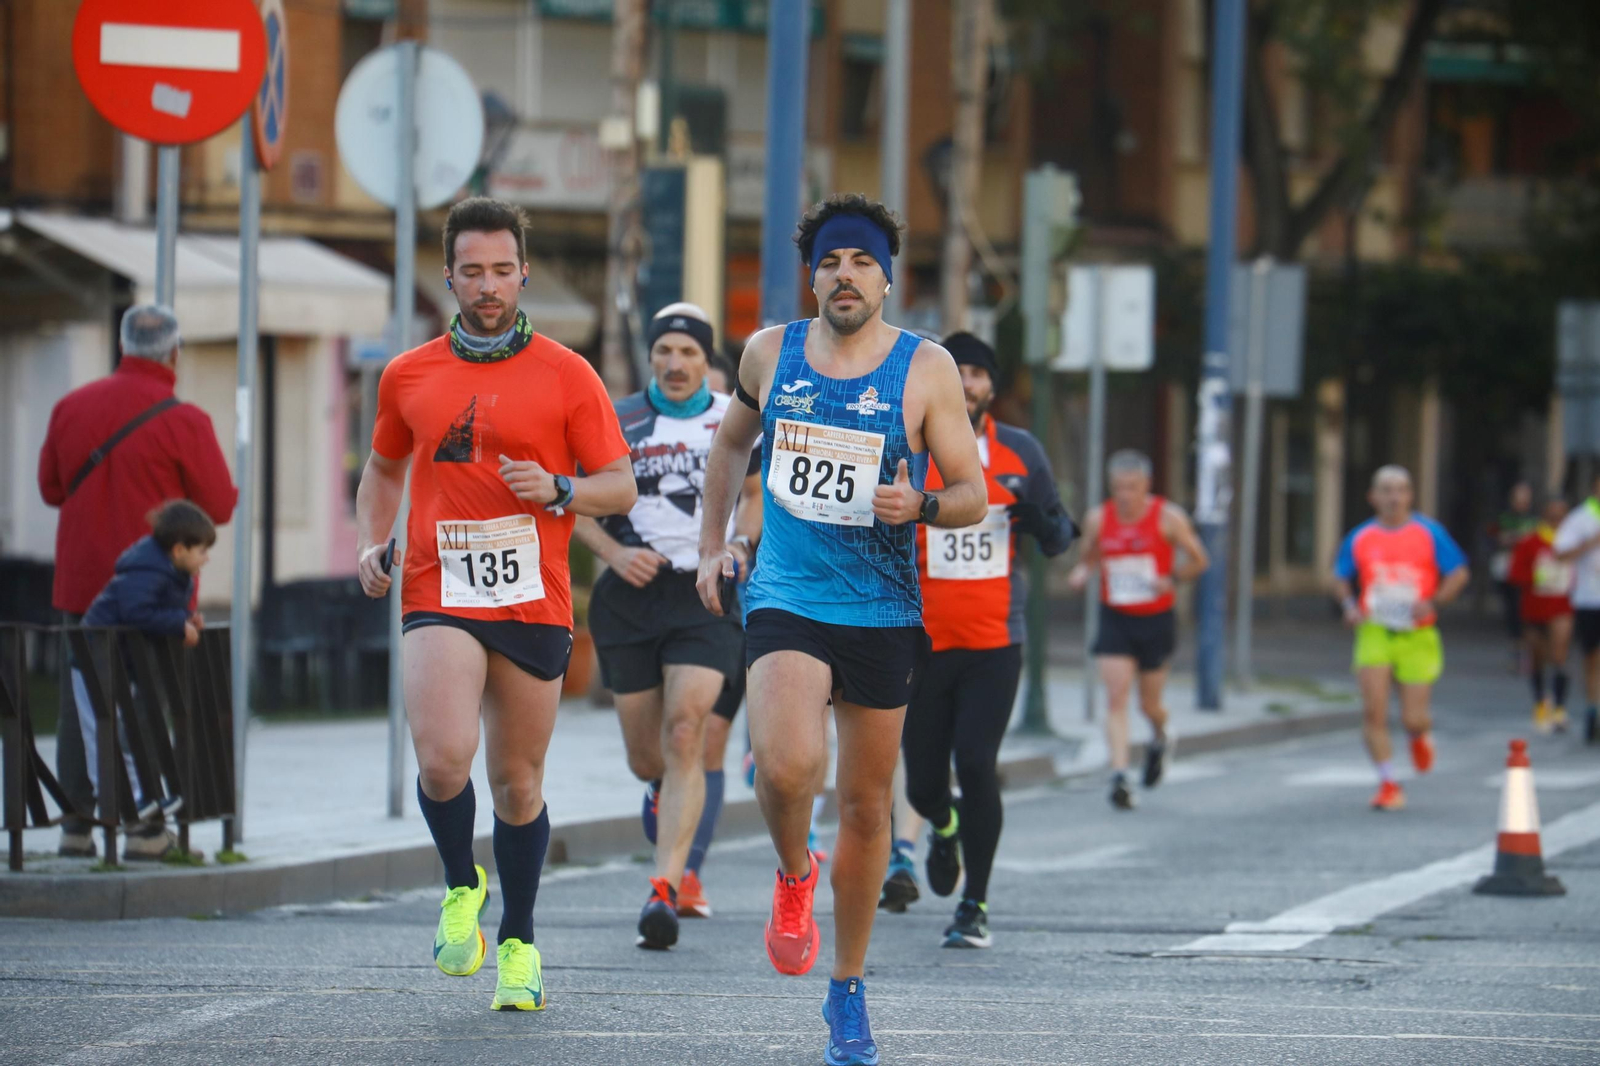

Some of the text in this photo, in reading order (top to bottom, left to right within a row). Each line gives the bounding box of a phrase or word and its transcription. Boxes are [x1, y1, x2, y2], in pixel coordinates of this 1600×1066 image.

[778, 423, 810, 453] XLI
[823, 430, 867, 444] CARRERA POPULAR
[809, 448, 834, 457] MEMORIAL
[789, 456, 856, 504] 825
[442, 524, 469, 550] XLI
[943, 532, 992, 562] 355
[460, 549, 520, 588] 135
